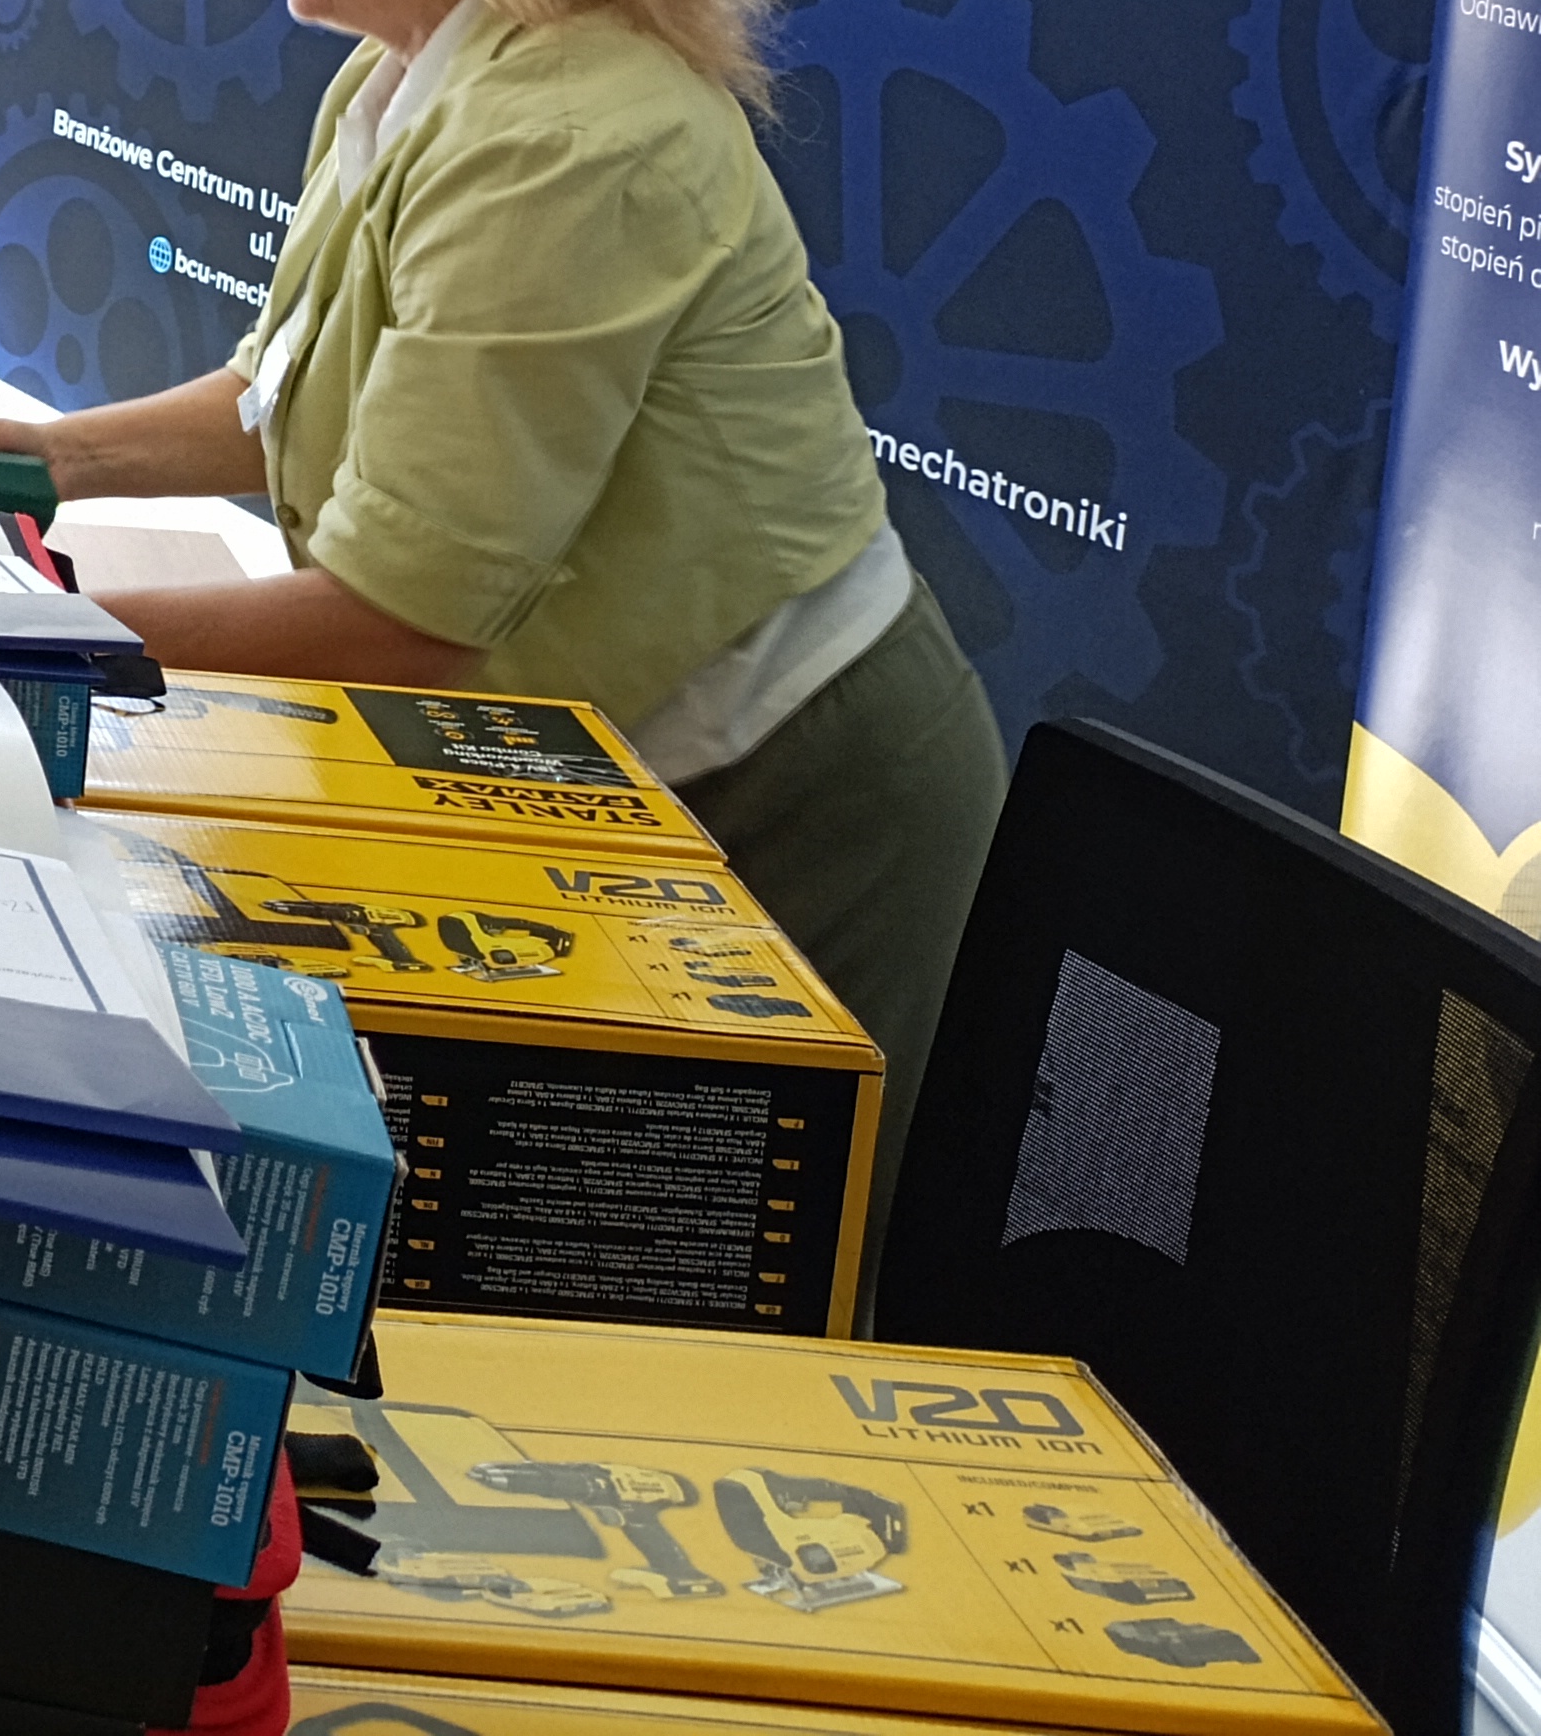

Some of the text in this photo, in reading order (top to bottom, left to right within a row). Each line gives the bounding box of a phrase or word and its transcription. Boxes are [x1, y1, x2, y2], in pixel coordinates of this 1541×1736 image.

[53, 109, 153, 171] Branżowe
[157, 150, 254, 210] Centrum
[1434, 186, 1512, 231] stopień
[250, 231, 277, 263] ul.
[1441, 235, 1524, 282] stopień
[175, 248, 270, 308] bcu-mech
[56, 695, 70, 757] CMP-1010
[429, 780, 644, 810] FATMAX
[434, 793, 662, 826] STANLEY
[544, 867, 728, 904] V20
[561, 892, 736, 916] LITHIUM ION
[626, 934, 648, 944] x1
[198, 959, 236, 1019] VFD, LowZ
[229, 964, 272, 1044] 1000 A AC/DC
[117, 1248, 128, 1268] VFD
[316, 1218, 350, 1314] CMP-1010
[336, 1222, 366, 1311] Miernik cęgowy
[64, 1348, 80, 1383] Pomiar
[95, 1356, 108, 1384] HOLD
[135, 1366, 151, 1403] Latarka
[64, 1352, 94, 1464] PEAK MAX PEAK MIN
[830, 1374, 1084, 1437] V20
[862, 1424, 1103, 1455] LITHIUM ION
[211, 1431, 245, 1525] CMP-1010
[231, 1435, 261, 1522] Miernik cęgowy
[963, 1501, 995, 1517] x1
[1004, 1558, 1037, 1575] x1
[1049, 1617, 1084, 1635] x1
